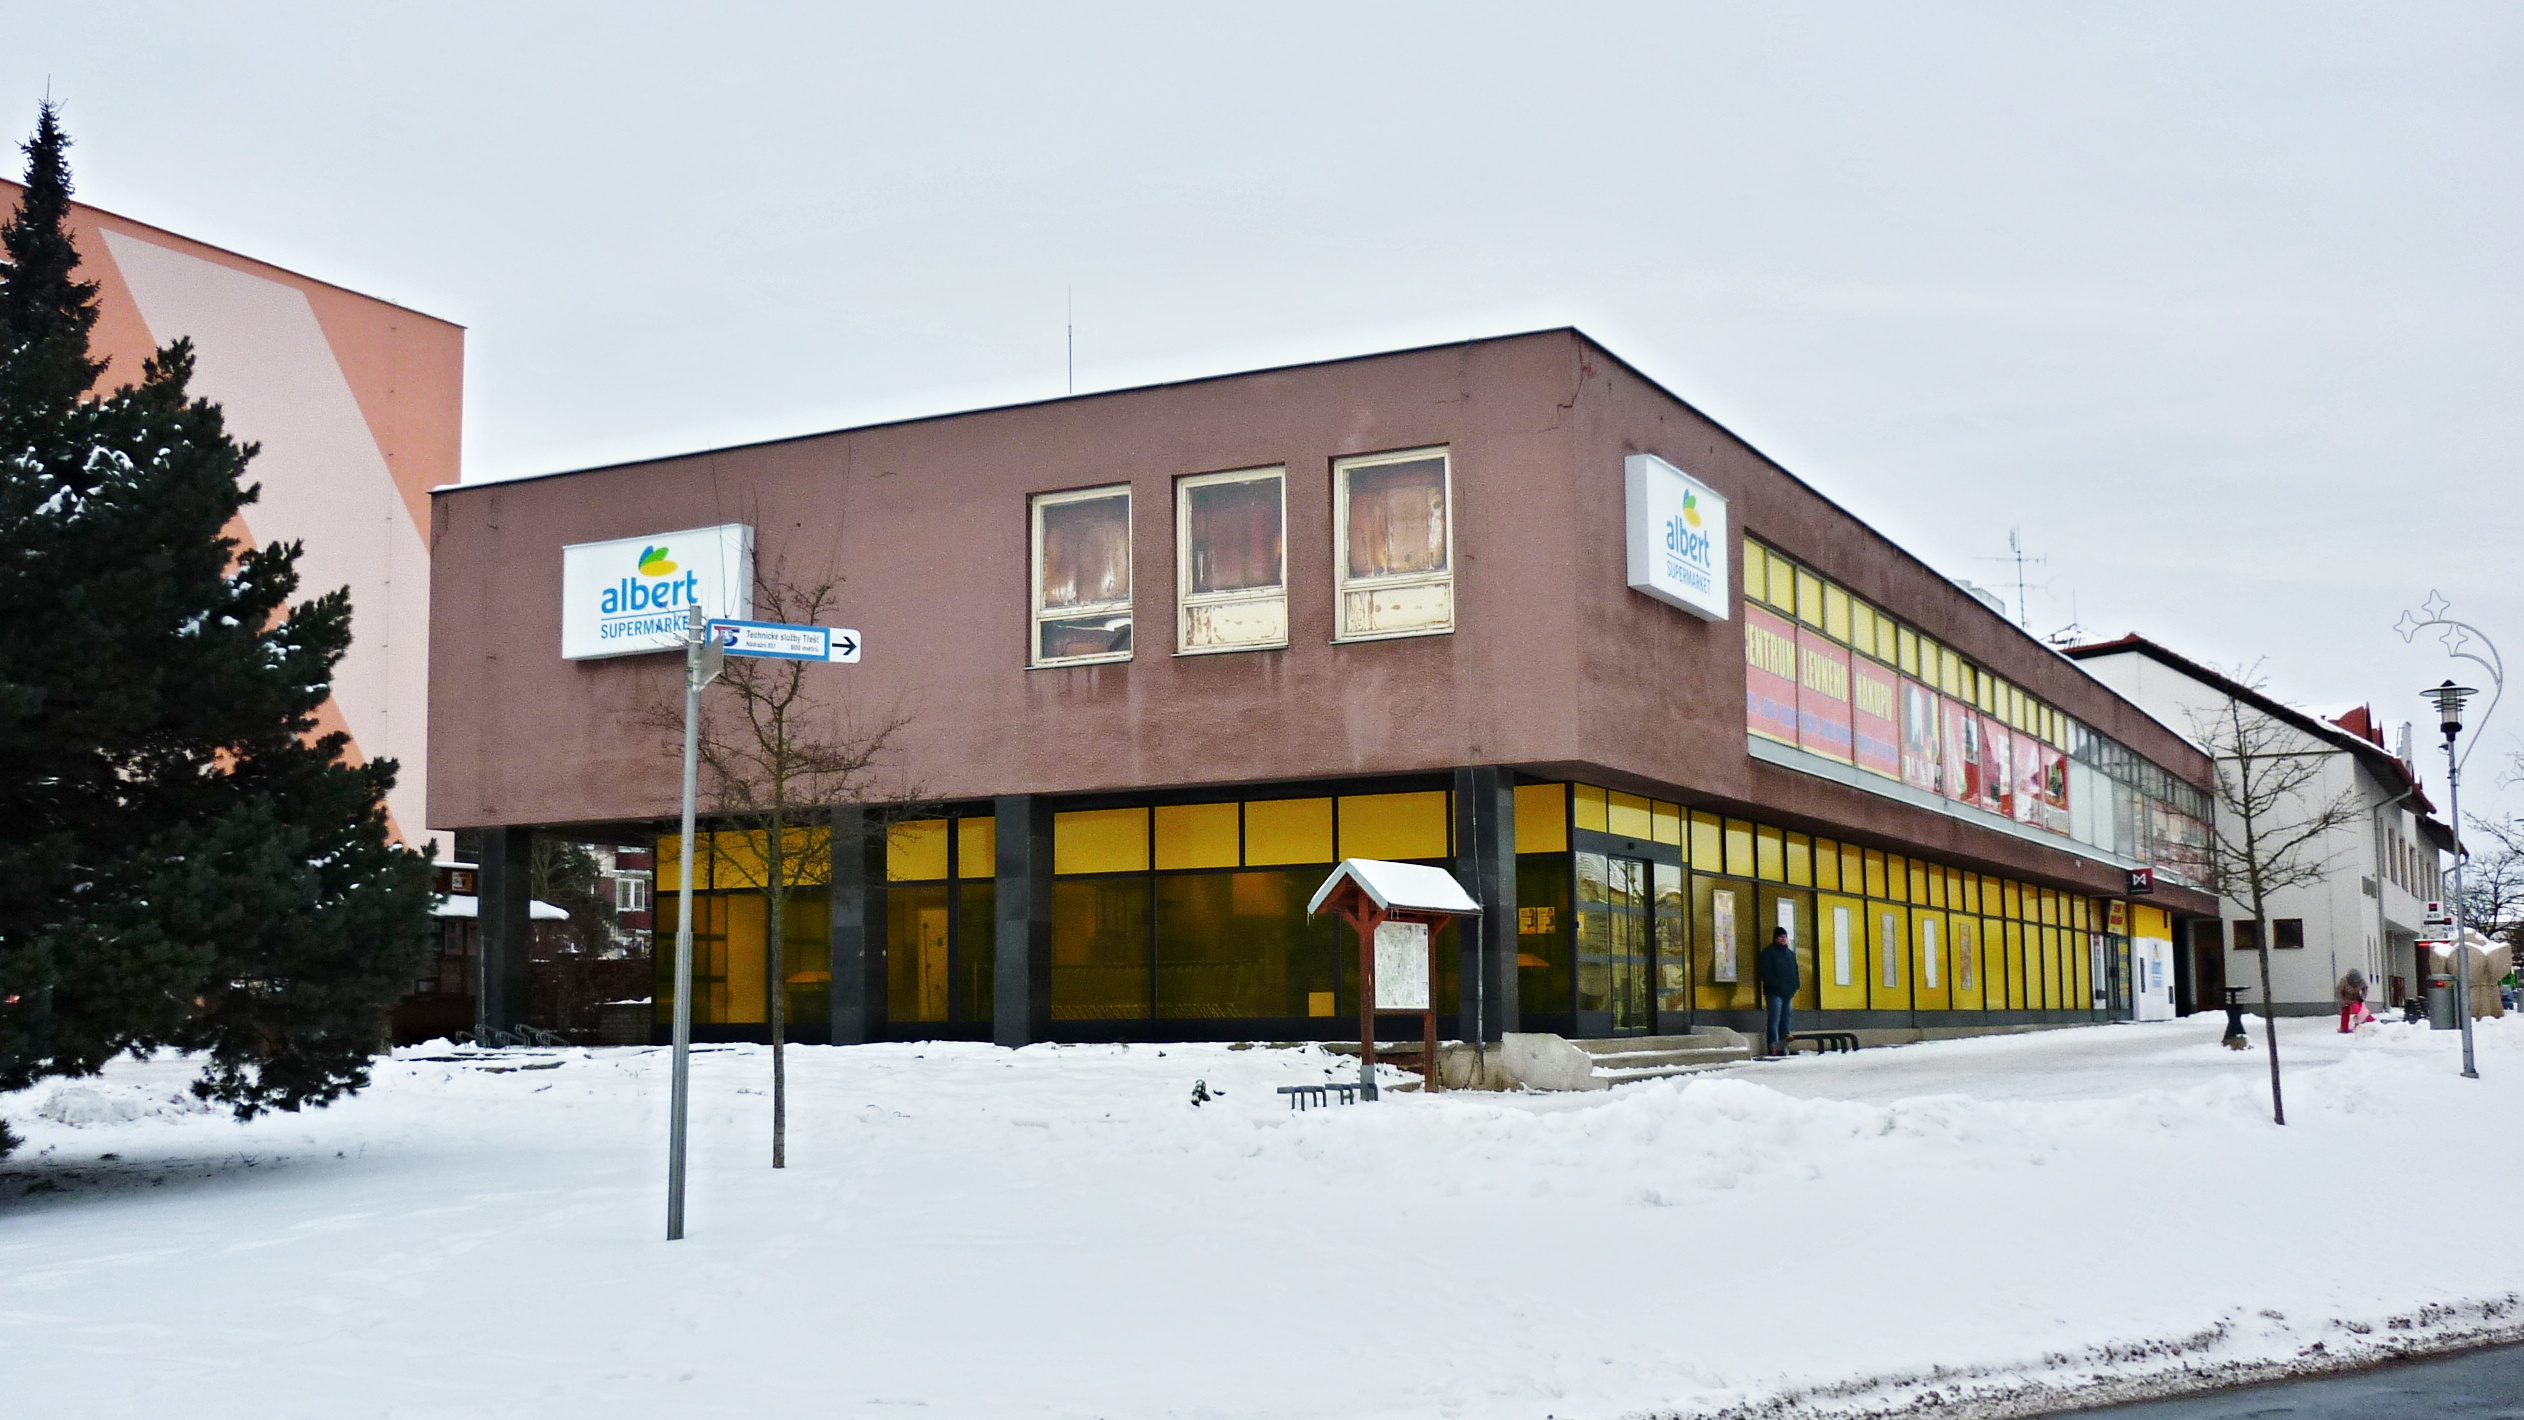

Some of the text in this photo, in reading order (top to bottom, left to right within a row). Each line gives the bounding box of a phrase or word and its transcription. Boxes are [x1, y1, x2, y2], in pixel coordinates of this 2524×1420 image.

[1666, 515, 1710, 569] albert
[601, 570, 698, 614] albert
[1667, 560, 1711, 595] SUPERMARKET
[601, 613, 689, 639] SUPERMARKE
[746, 630, 778, 641] Technické
[780, 632, 801, 644] služby
[1803, 648, 1848, 703] LEVNÉHO
